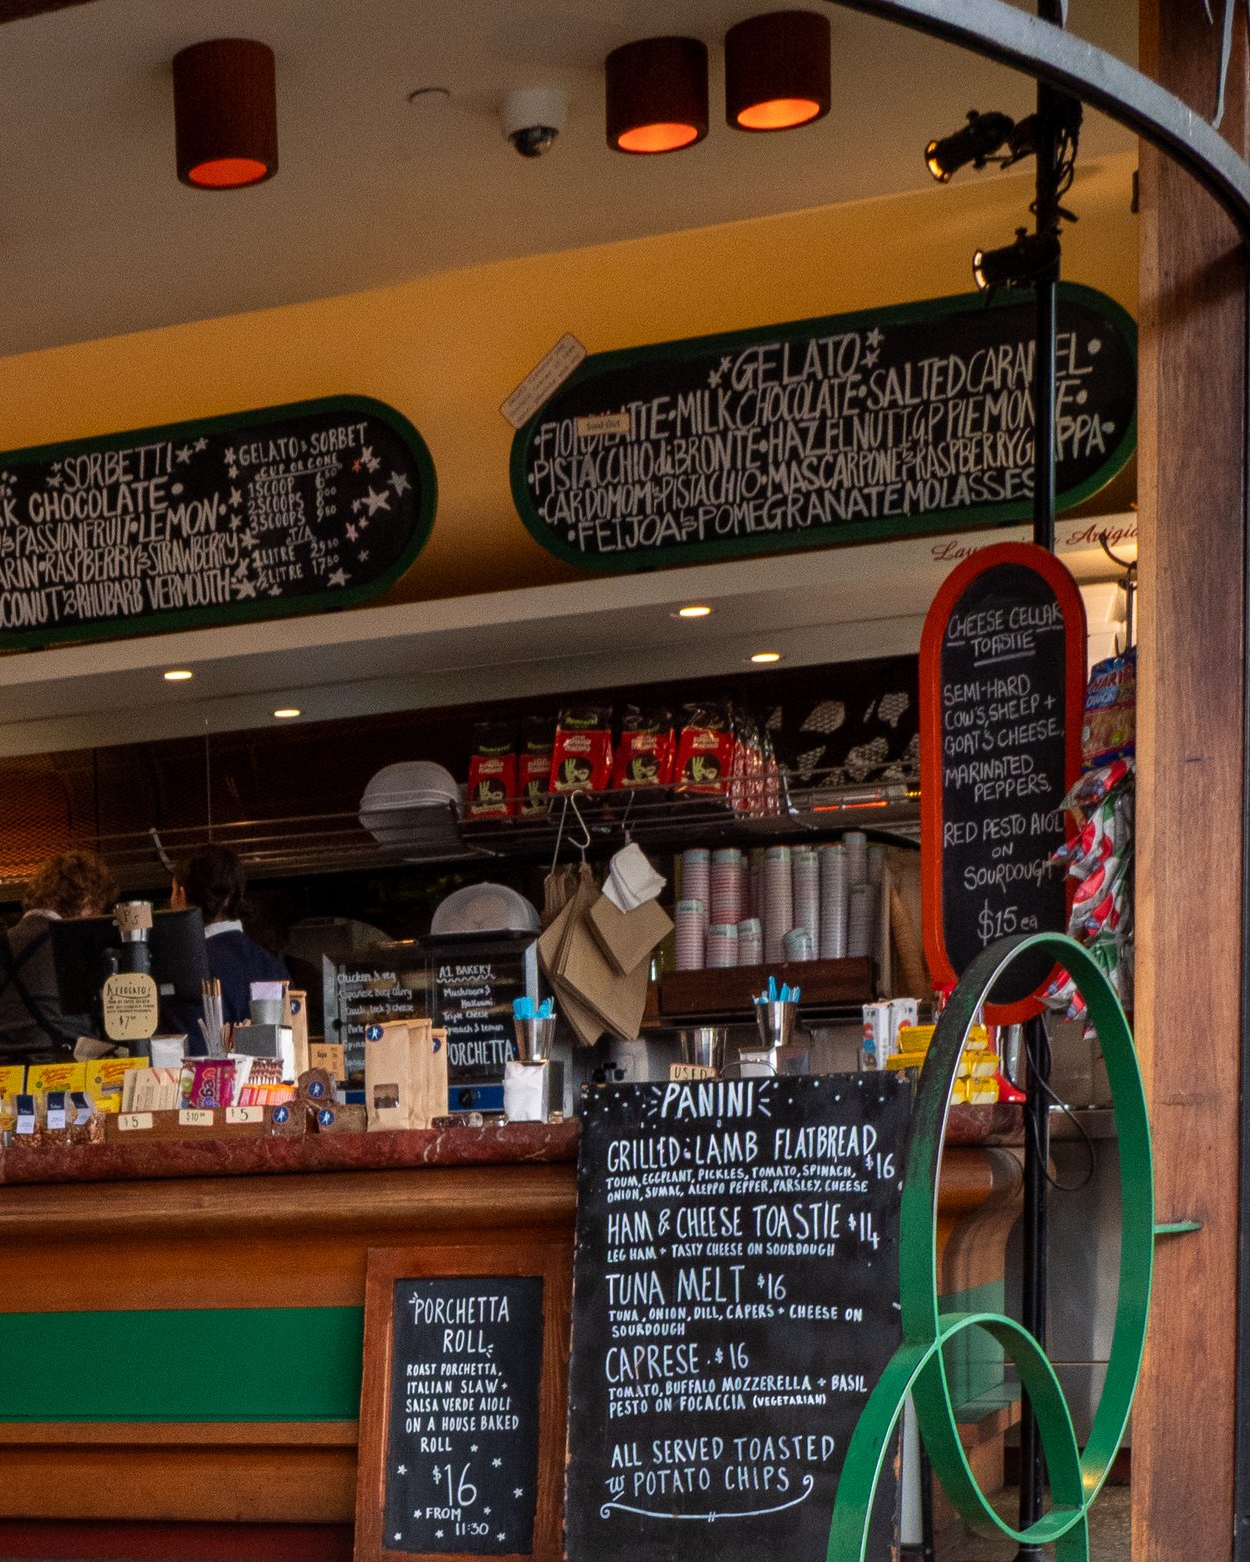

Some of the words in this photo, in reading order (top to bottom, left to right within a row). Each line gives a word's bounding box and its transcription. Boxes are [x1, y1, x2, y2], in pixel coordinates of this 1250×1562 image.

[732, 333, 861, 391] GELATO
[677, 387, 735, 437] MILK
[736, 374, 862, 430] CHOCOLATE
[866, 354, 966, 410] SALTED
[239, 437, 298, 466] GELATO
[310, 422, 367, 455] SORBET
[63, 441, 172, 492] SORBETTI
[535, 441, 654, 496] PISTACCHIO
[674, 427, 761, 475] BRONTE
[544, 481, 651, 525] CARDOMOM
[661, 468, 762, 513] PISTACHIO
[767, 449, 901, 497] MASCARPONE
[915, 430, 1018, 480] RASPBERRY
[29, 476, 168, 523] CHOCOLATE
[16, 514, 135, 557] PASSIONFRUIT
[139, 491, 219, 543] LEMON
[578, 512, 681, 552] FEIJOA
[699, 484, 903, 540] POMEGRANATE
[45, 544, 142, 583] RASPBERRY
[147, 532, 239, 576] STRAWBERRY
[76, 579, 143, 619] RHUBARB
[146, 568, 230, 610] VERMOUTH
[948, 609, 1005, 640] CHEESE
[944, 674, 1030, 706] SEMI-HARD
[945, 730, 994, 756] GOAT'S
[945, 754, 1034, 789] MARINATED
[974, 773, 1052, 803] PEPPERS,
[943, 821, 979, 848] RED
[982, 814, 1027, 841] PESTO
[992, 842, 1014, 858] ON
[964, 851, 1052, 894] SOURDOUGH
[977, 899, 1018, 947] $15
[1020, 915, 1038, 930] ea
[456, 964, 492, 978] BAKERY
[674, 1066, 708, 1080] USED
[661, 1081, 754, 1118] PANINI
[608, 1136, 680, 1172] GRILLED
[695, 1131, 758, 1165] LAMB
[774, 1124, 877, 1160] FLATBREAD
[865, 1152, 895, 1179] $16
[606, 1175, 642, 1190] TOUM,
[642, 1169, 695, 1186] EGGPLANT,
[698, 1168, 749, 1181] PICKLES,
[752, 1165, 801, 1179] TOMATO,
[802, 1164, 856, 1179] SPINACH,
[607, 1188, 643, 1204] ONION,
[645, 1185, 684, 1198] SUMAC,
[688, 1182, 725, 1195] ALEPPO
[730, 1180, 772, 1194] PEPPER,
[773, 1179, 822, 1193] PARSLEY,
[825, 1180, 869, 1193] CHEESE
[607, 1210, 654, 1245] HAM
[658, 1208, 670, 1236] &
[676, 1206, 743, 1239] CHEESE
[752, 1200, 841, 1240] TOASTIE
[848, 1211, 880, 1250] $14
[607, 1248, 626, 1263] LEG
[630, 1245, 657, 1260] HAM
[671, 1243, 703, 1258] TASTY
[706, 1242, 743, 1256] CHEESE
[747, 1242, 763, 1256] ON
[766, 1242, 835, 1257] SOURDOUGH
[605, 1270, 665, 1305] TUNA
[677, 1265, 745, 1303] MELT
[757, 1273, 787, 1300] $16
[414, 1295, 510, 1325] PORCHETTA
[649, 1306, 691, 1321] ONION,
[694, 1305, 723, 1320] DILL,
[726, 1303, 775, 1319] CAPERS
[789, 1304, 838, 1320] CHEESE
[845, 1308, 863, 1322] ON
[443, 1329, 487, 1354] ROLL
[612, 1322, 686, 1338] SOURDOUGH
[406, 1363, 436, 1377] ROAST
[440, 1362, 502, 1377] PORCHETTA,
[605, 1343, 700, 1383] CAPRESE
[406, 1380, 452, 1395] ITALIAN
[460, 1379, 498, 1395] SLAW
[608, 1383, 663, 1400] TOMATO,
[665, 1379, 716, 1395] BUFFALO
[721, 1375, 812, 1392] MOZZERELLA
[831, 1374, 868, 1393] BASIL
[405, 1398, 439, 1413] SALSA
[442, 1397, 474, 1412] VERDE
[479, 1396, 511, 1412] AIOLI
[609, 1399, 648, 1419] PESTO
[655, 1397, 672, 1412] ON
[680, 1393, 746, 1412] FOCACCIA
[752, 1393, 827, 1408] (VEGETARIAN)
[405, 1418, 421, 1434] ON
[427, 1416, 436, 1432] A
[441, 1416, 477, 1432] HOUSE
[480, 1414, 520, 1431] BAKED
[420, 1436, 452, 1453] ROLL
[611, 1442, 643, 1468] ALL
[652, 1436, 724, 1464] SERVED
[733, 1435, 835, 1462] TOASTED
[432, 1462, 478, 1508] $16
[634, 1467, 710, 1497] POTATO
[725, 1465, 790, 1492] CHIPS
[425, 1507, 462, 1522] FROM
[455, 1522, 489, 1536] 11:30
